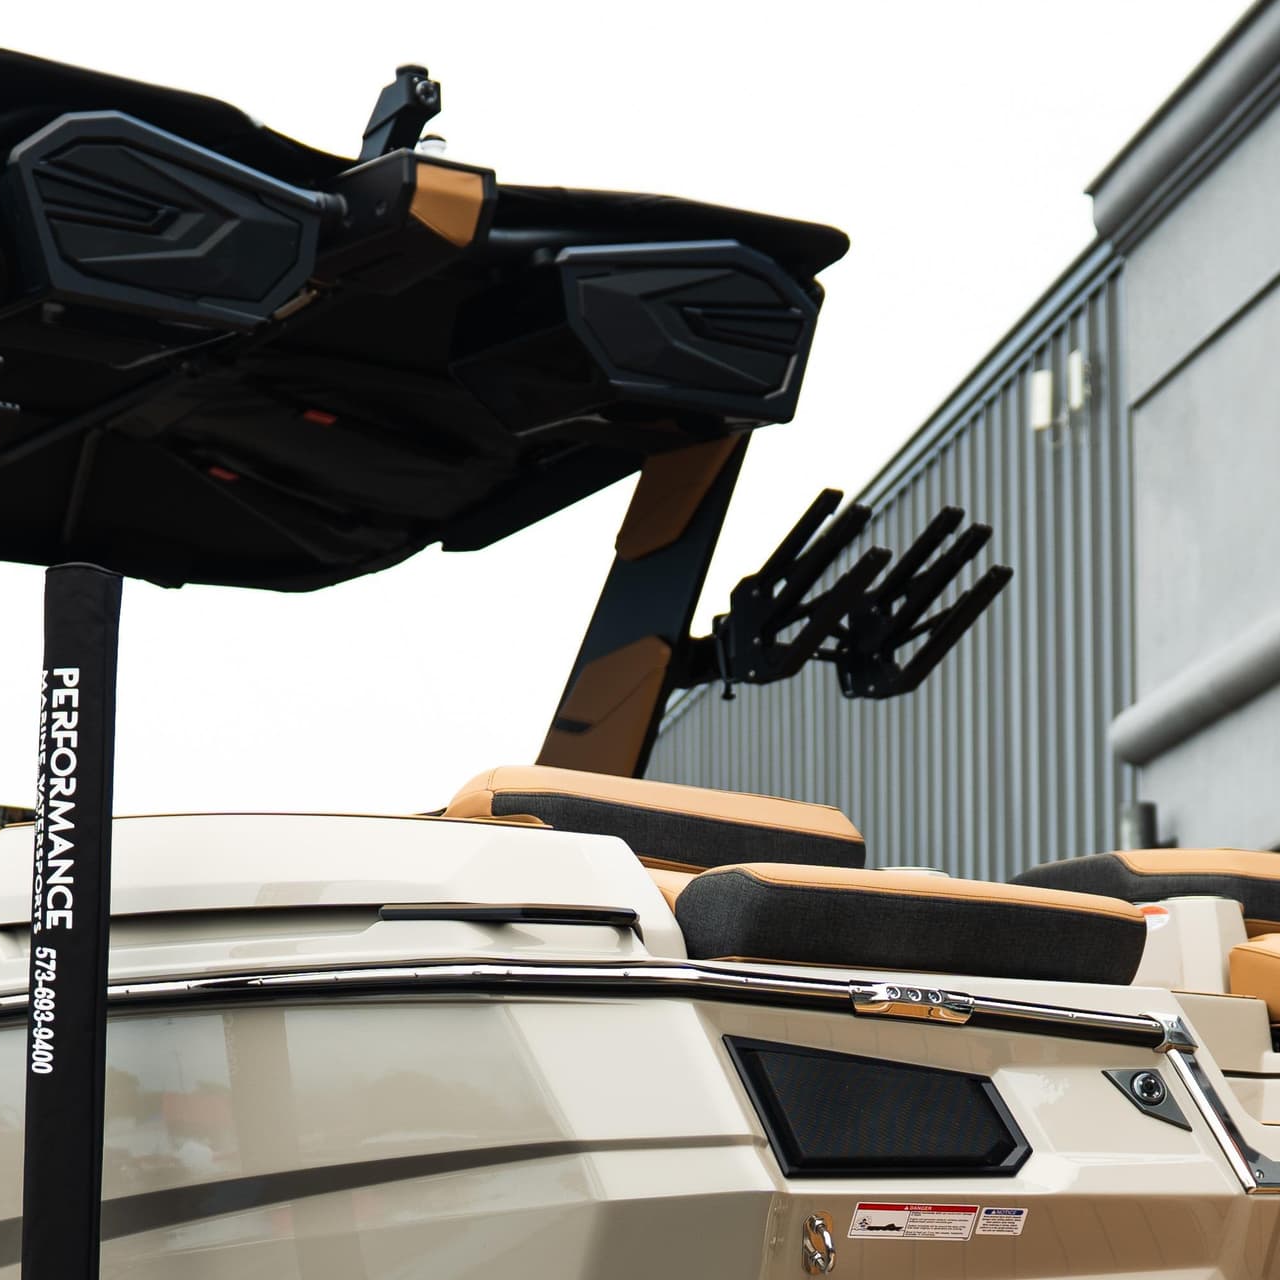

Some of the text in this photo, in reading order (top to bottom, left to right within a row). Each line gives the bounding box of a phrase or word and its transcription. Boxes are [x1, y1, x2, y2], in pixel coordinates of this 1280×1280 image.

[33, 669, 49, 935] MARINE WATERSPORTS
[46, 667, 80, 930] PERFORMANCE
[31, 946, 57, 1074] 573-693-9400
